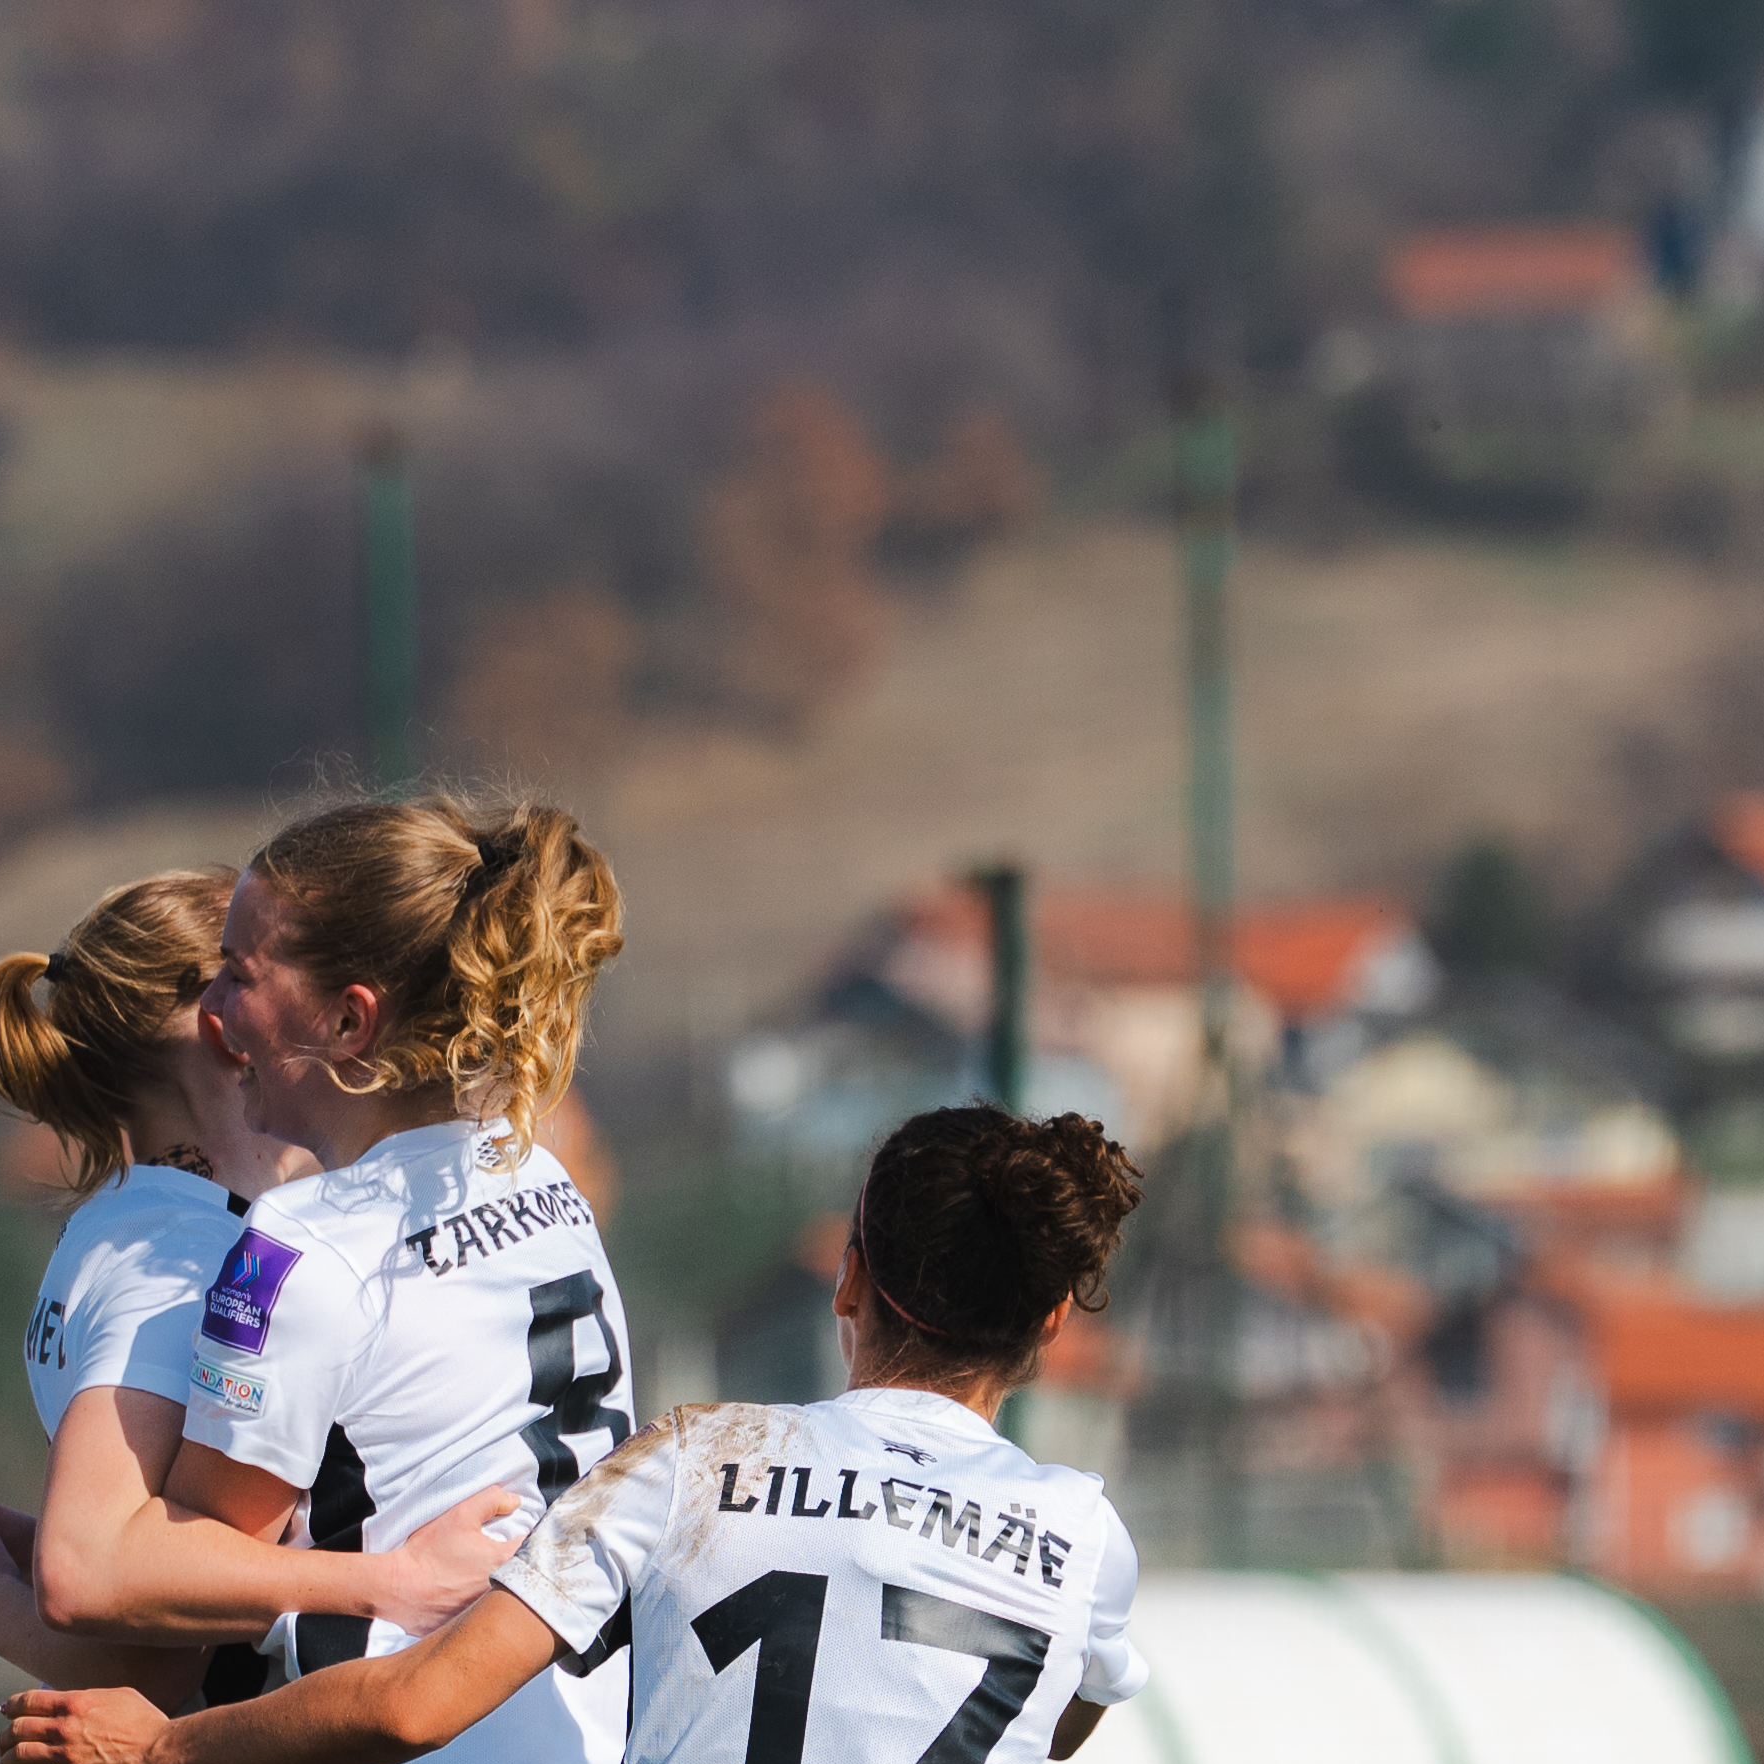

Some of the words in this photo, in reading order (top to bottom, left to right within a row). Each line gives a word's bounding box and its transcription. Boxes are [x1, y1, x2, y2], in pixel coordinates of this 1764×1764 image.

[209, 1302, 261, 1329] QUALIFIERS
[211, 1290, 262, 1317] EUROPEAN
[519, 1268, 631, 1506] 8
[717, 1463, 1072, 1589] LILLEMÄE
